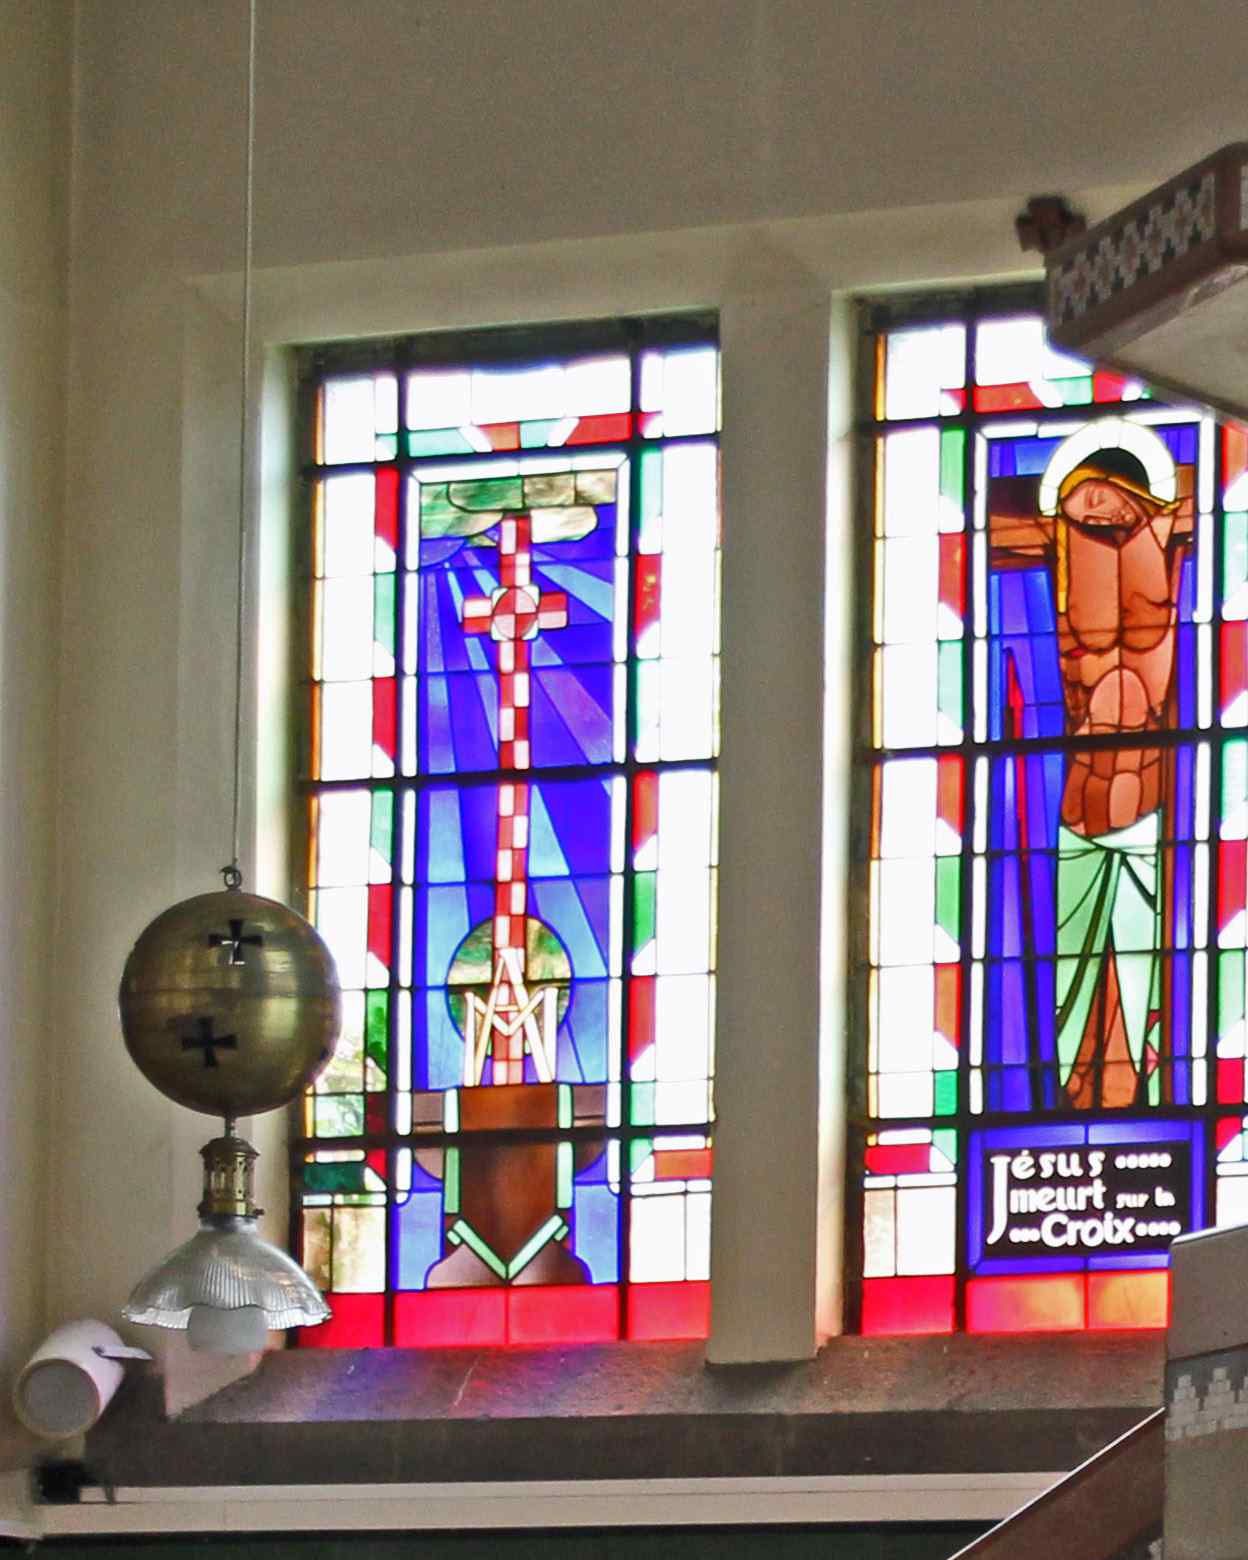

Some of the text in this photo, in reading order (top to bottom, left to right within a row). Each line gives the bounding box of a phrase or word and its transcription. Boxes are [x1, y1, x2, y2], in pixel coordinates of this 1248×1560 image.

[1009, 1177, 1176, 1214] meurt sur la
[1041, 1210, 1136, 1248] Croix
